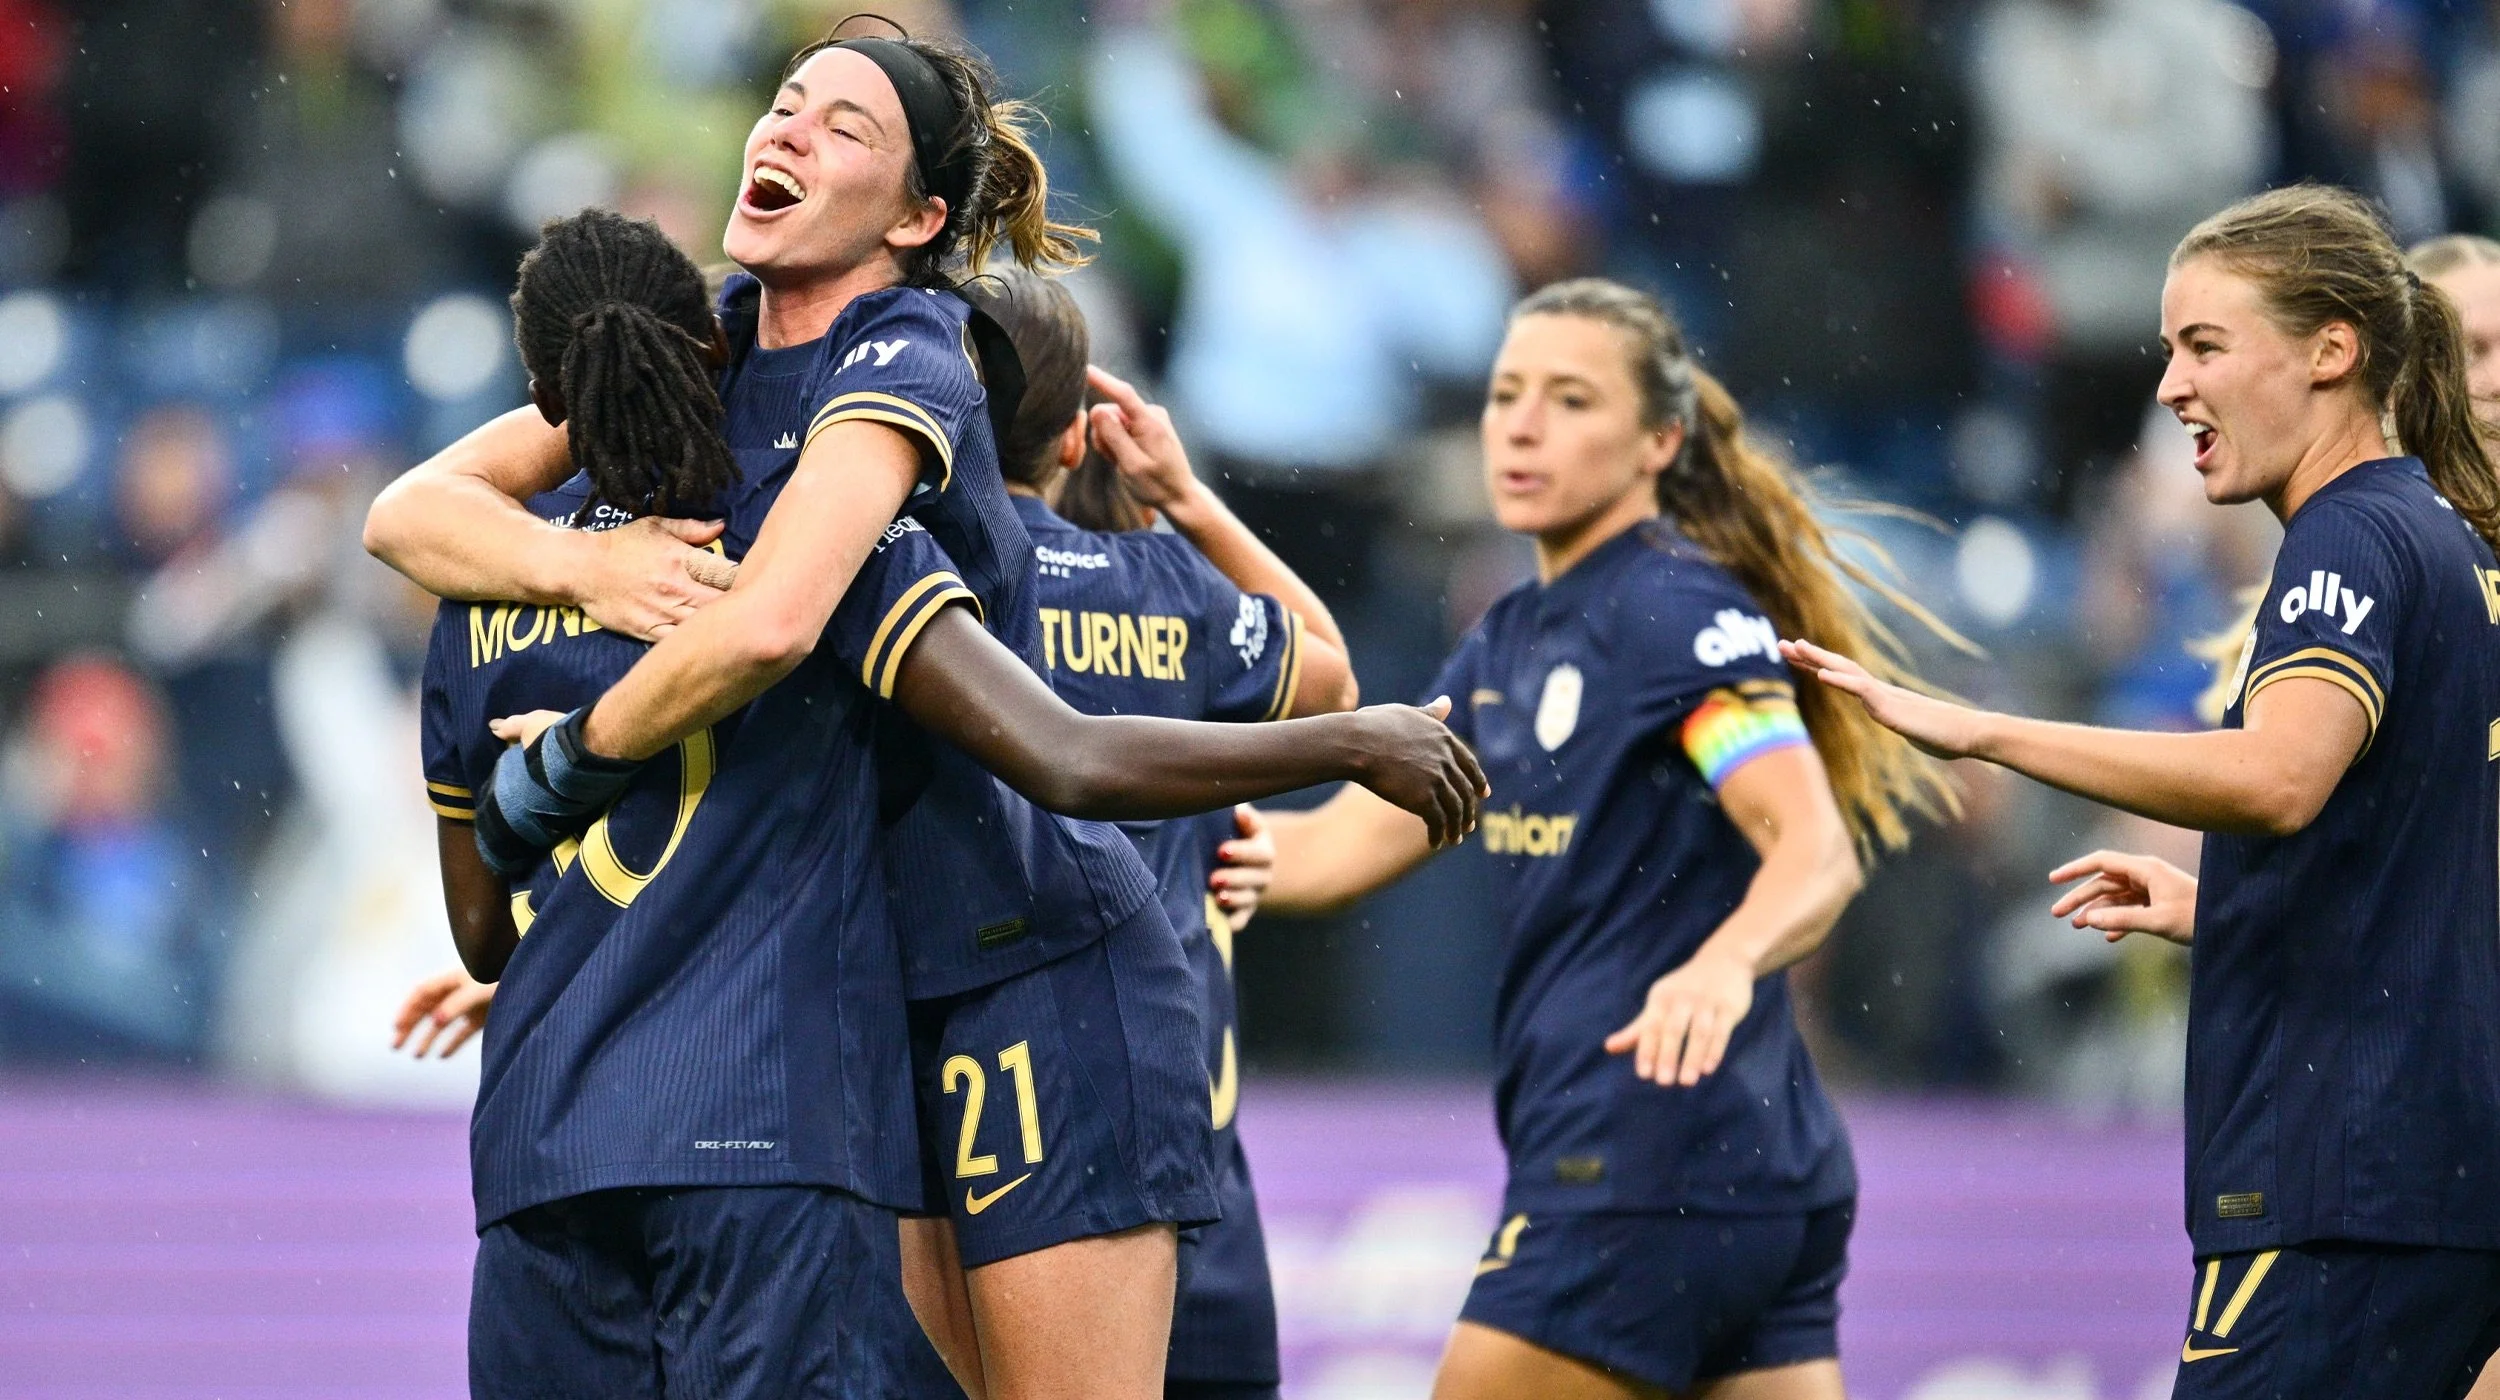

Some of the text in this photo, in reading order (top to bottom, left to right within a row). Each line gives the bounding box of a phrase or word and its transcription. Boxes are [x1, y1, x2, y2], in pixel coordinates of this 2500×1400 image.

[834, 339, 911, 376] lly
[1035, 545, 1111, 570] CHOICE
[2280, 570, 2375, 636] olly
[1039, 608, 1189, 681] TURNER
[941, 1039, 1043, 1179] 21
